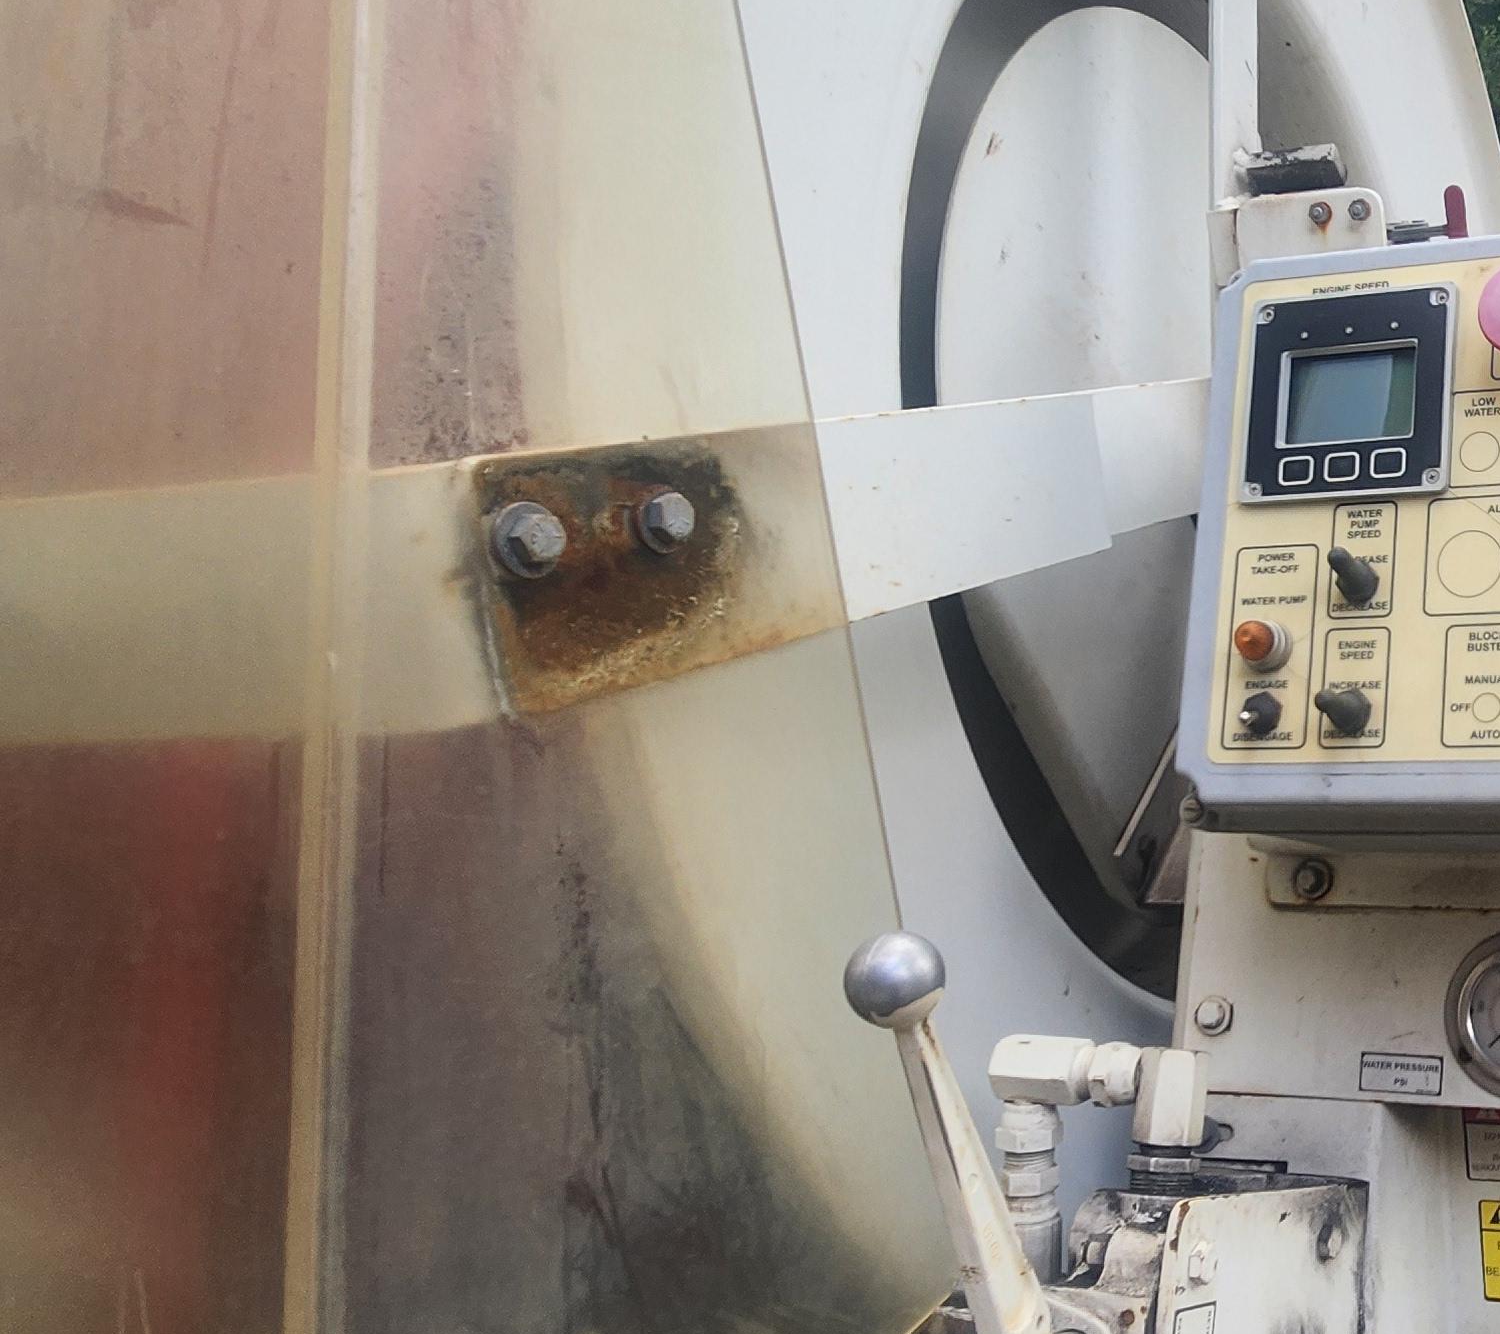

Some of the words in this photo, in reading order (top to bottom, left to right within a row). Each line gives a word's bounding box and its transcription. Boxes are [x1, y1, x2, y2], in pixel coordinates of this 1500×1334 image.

[1471, 397, 1497, 407] LOW
[1464, 407, 1500, 417] WATER
[1347, 509, 1383, 519] WATER
[1350, 519, 1380, 529] PUMP
[1347, 529, 1382, 539] SPEED
[1258, 552, 1295, 563] POWER
[1251, 564, 1299, 575] TAKE-OFF
[1241, 596, 1276, 606] WATER
[1278, 595, 1308, 605] PUMP
[1338, 639, 1377, 650] ENGINE
[1339, 650, 1375, 660] SPEED
[1245, 680, 1289, 690] ENGAGE
[1329, 680, 1382, 690] INCREASE
[1450, 703, 1472, 712] OFF
[1470, 730, 1500, 739] AUTO
[1394, 1063, 1440, 1073] PRESSURE
